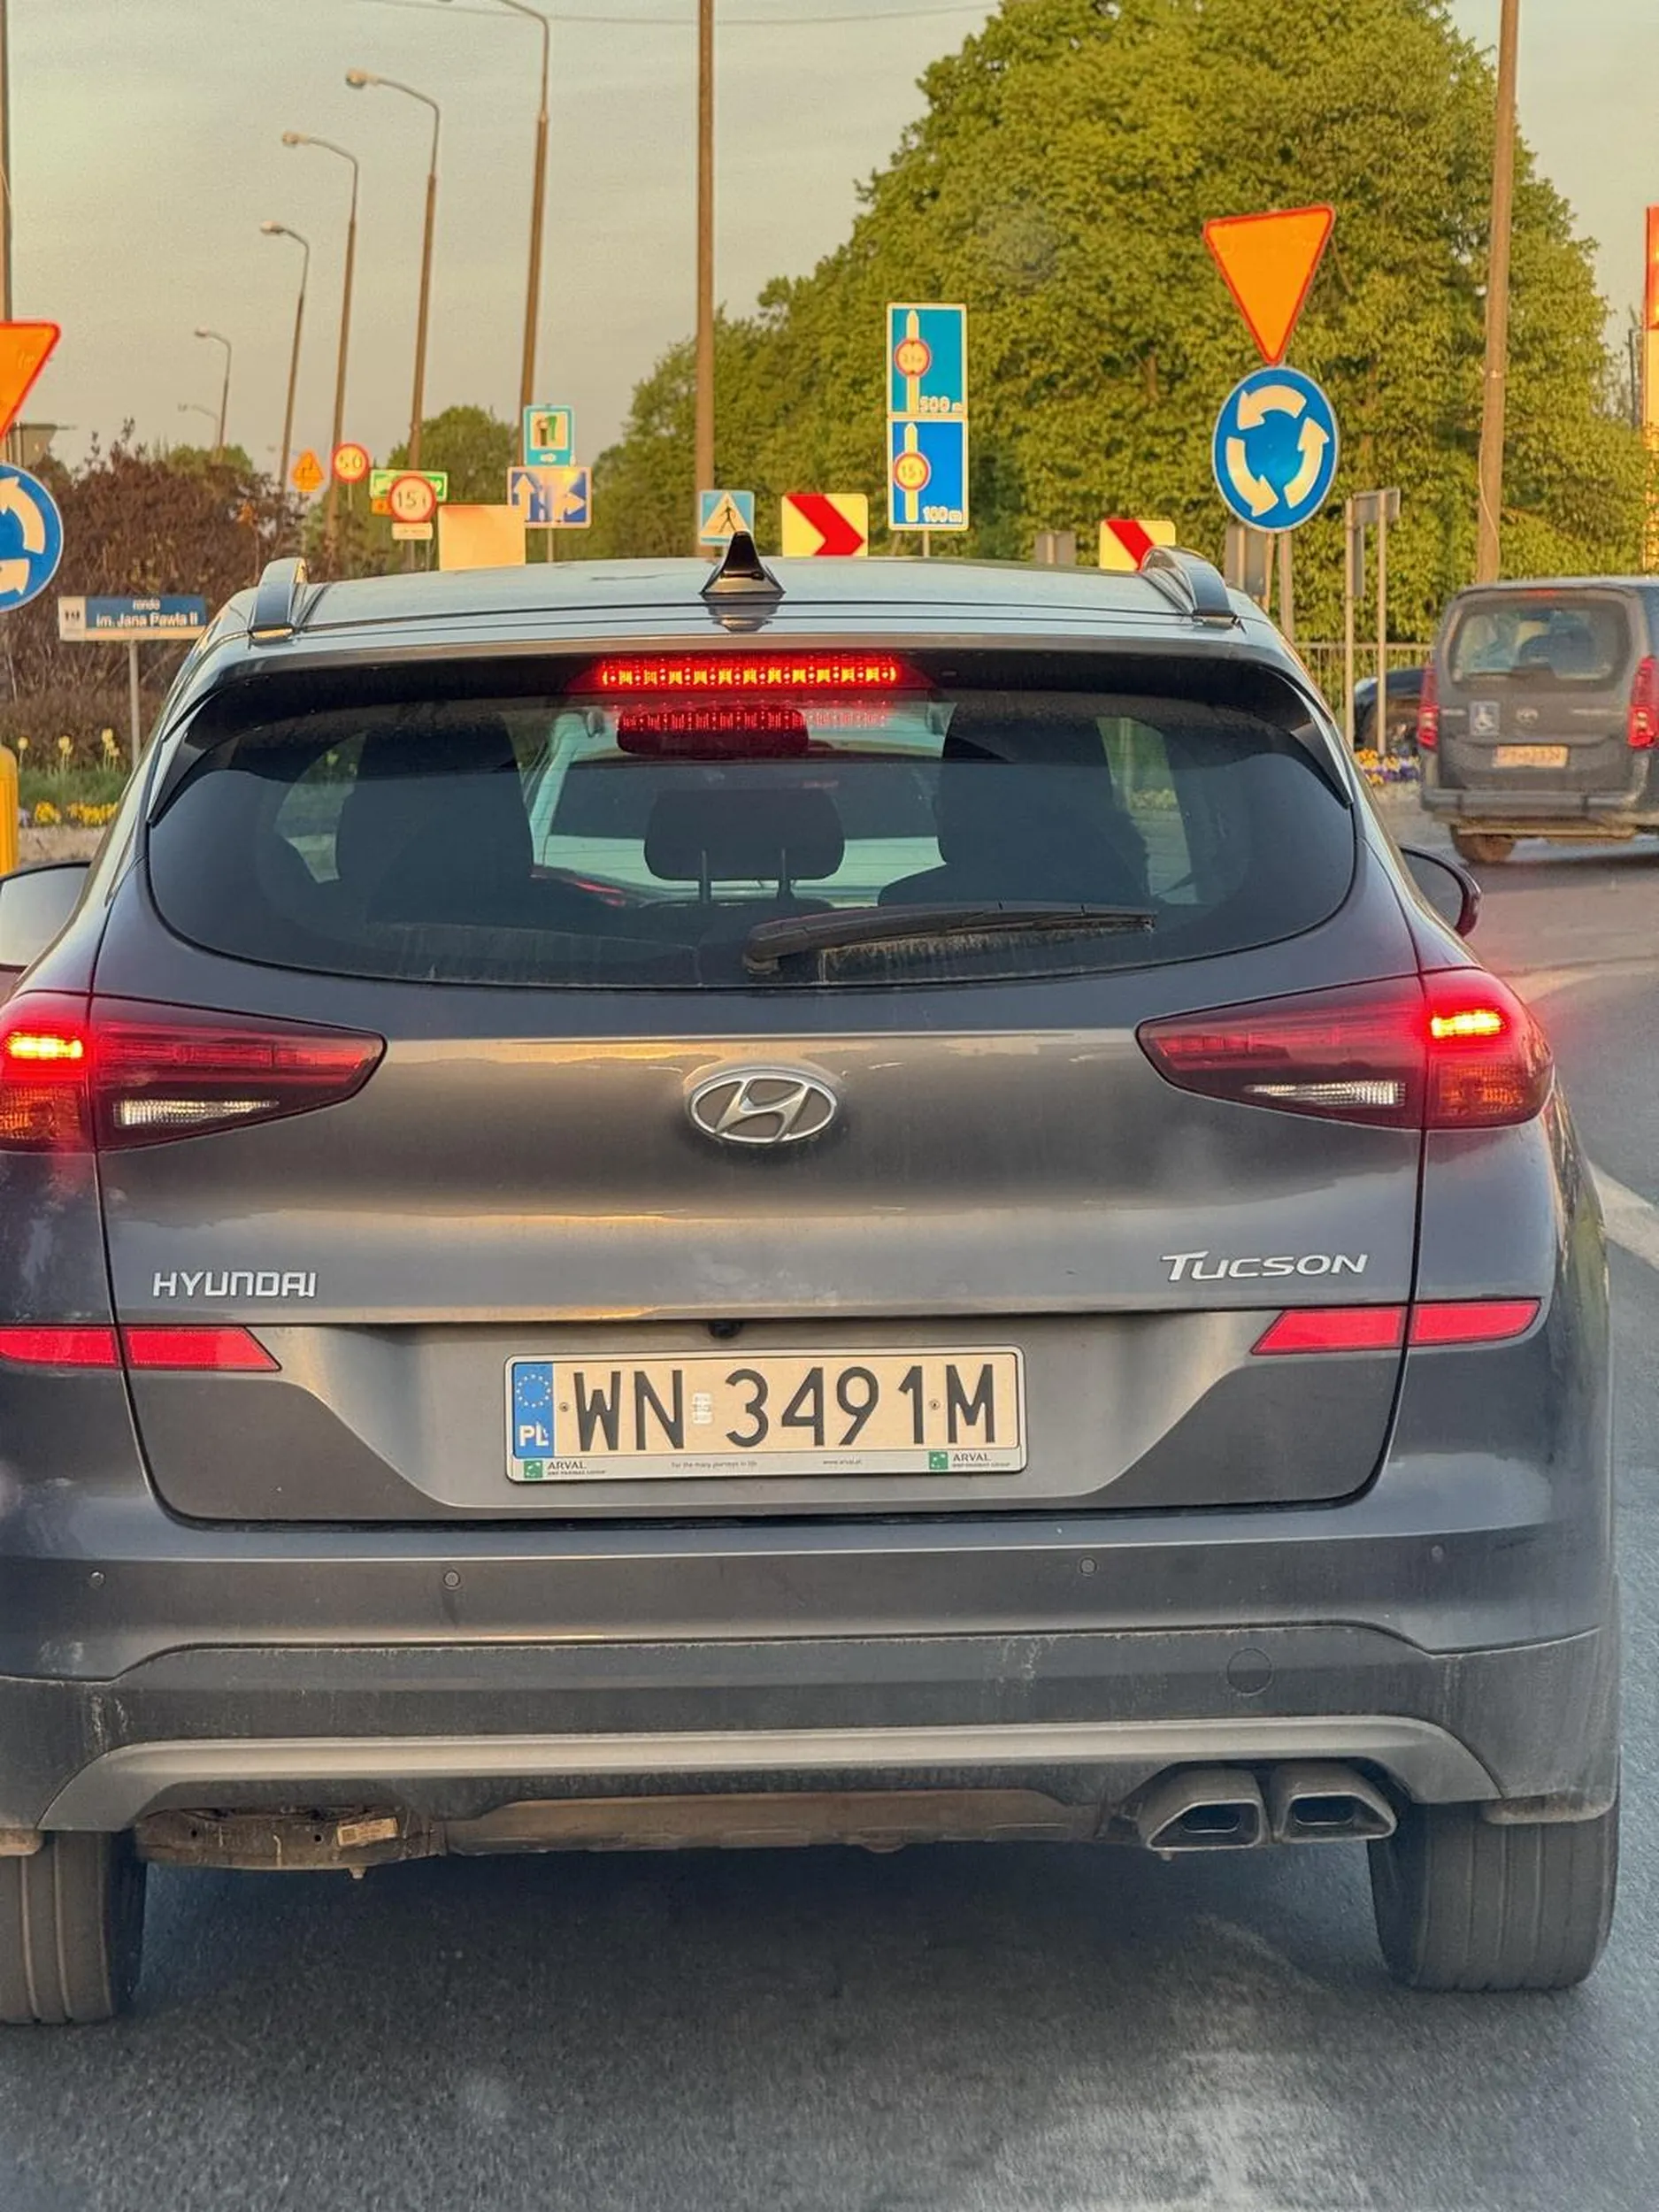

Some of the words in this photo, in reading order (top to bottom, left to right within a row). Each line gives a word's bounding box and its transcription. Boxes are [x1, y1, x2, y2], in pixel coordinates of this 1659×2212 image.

[117, 612, 147, 626] Jana
[1161, 1250, 1369, 1281] TUCSON
[152, 1271, 318, 1297] HYUNDAI
[573, 1370, 685, 1452] WN
[726, 1363, 995, 1448] 3491M
[519, 1424, 549, 1447] PL
[548, 1461, 587, 1470] ARVAL
[953, 1453, 991, 1462] ARVAL
